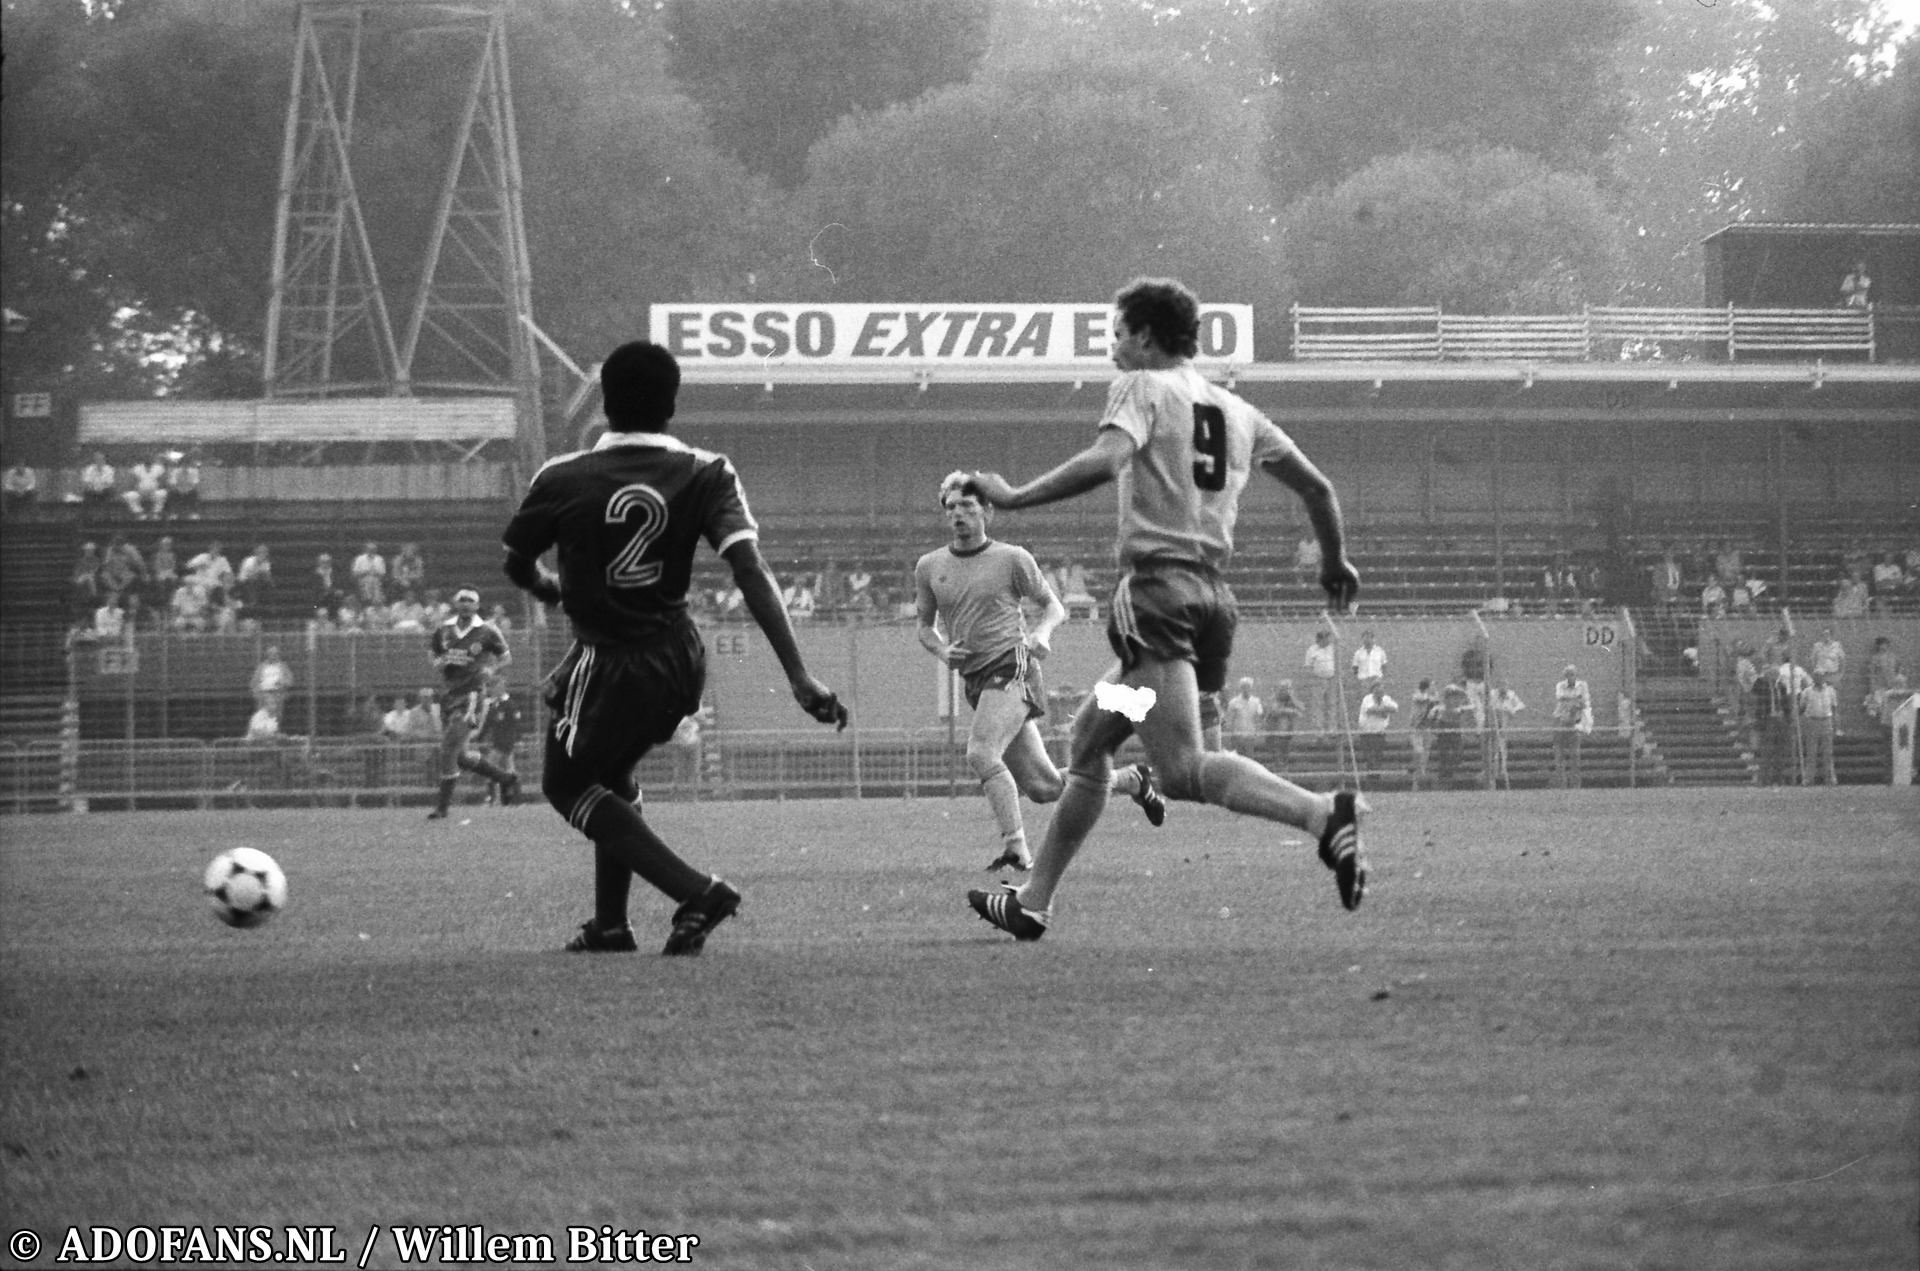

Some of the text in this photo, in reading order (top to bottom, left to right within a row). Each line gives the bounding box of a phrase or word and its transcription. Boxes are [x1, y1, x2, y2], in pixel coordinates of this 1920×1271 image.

[667, 311, 1238, 358] ESSO EXTRA EO
[1193, 402, 1226, 491] 9
[605, 483, 669, 587] 2
[1586, 626, 1614, 645] DD
